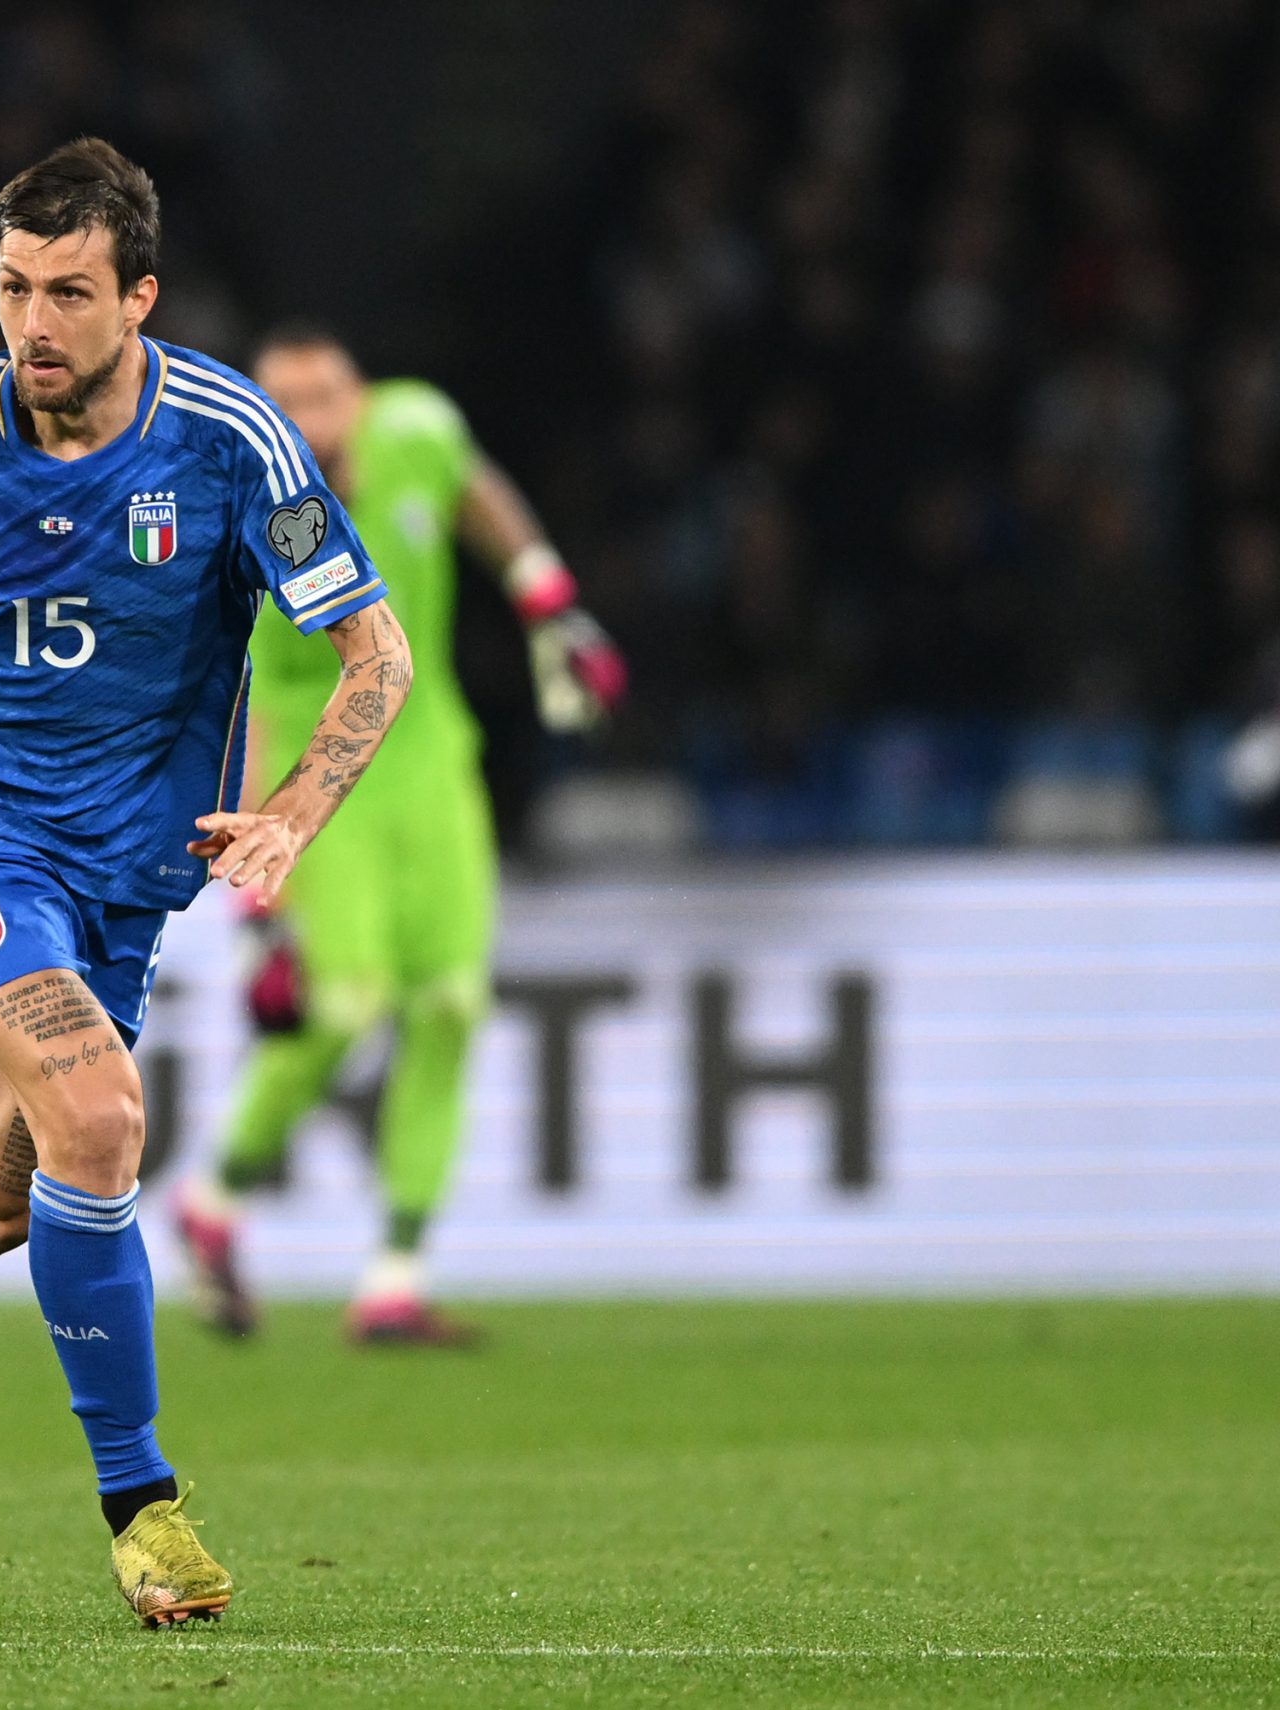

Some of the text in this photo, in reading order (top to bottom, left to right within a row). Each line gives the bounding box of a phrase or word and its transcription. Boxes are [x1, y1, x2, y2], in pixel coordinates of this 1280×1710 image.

[133, 507, 172, 522] ITALIA
[287, 561, 353, 600] FOUNDATION
[12, 596, 96, 669] 15
[6, 982, 42, 1003] GIORNO
[43, 978, 56, 988] TI
[0, 1003, 18, 1020] NON
[19, 1006, 45, 1024] FARE
[23, 1014, 60, 1035] SEMPRE
[41, 1053, 77, 1081] Day
[81, 1041, 100, 1066] by
